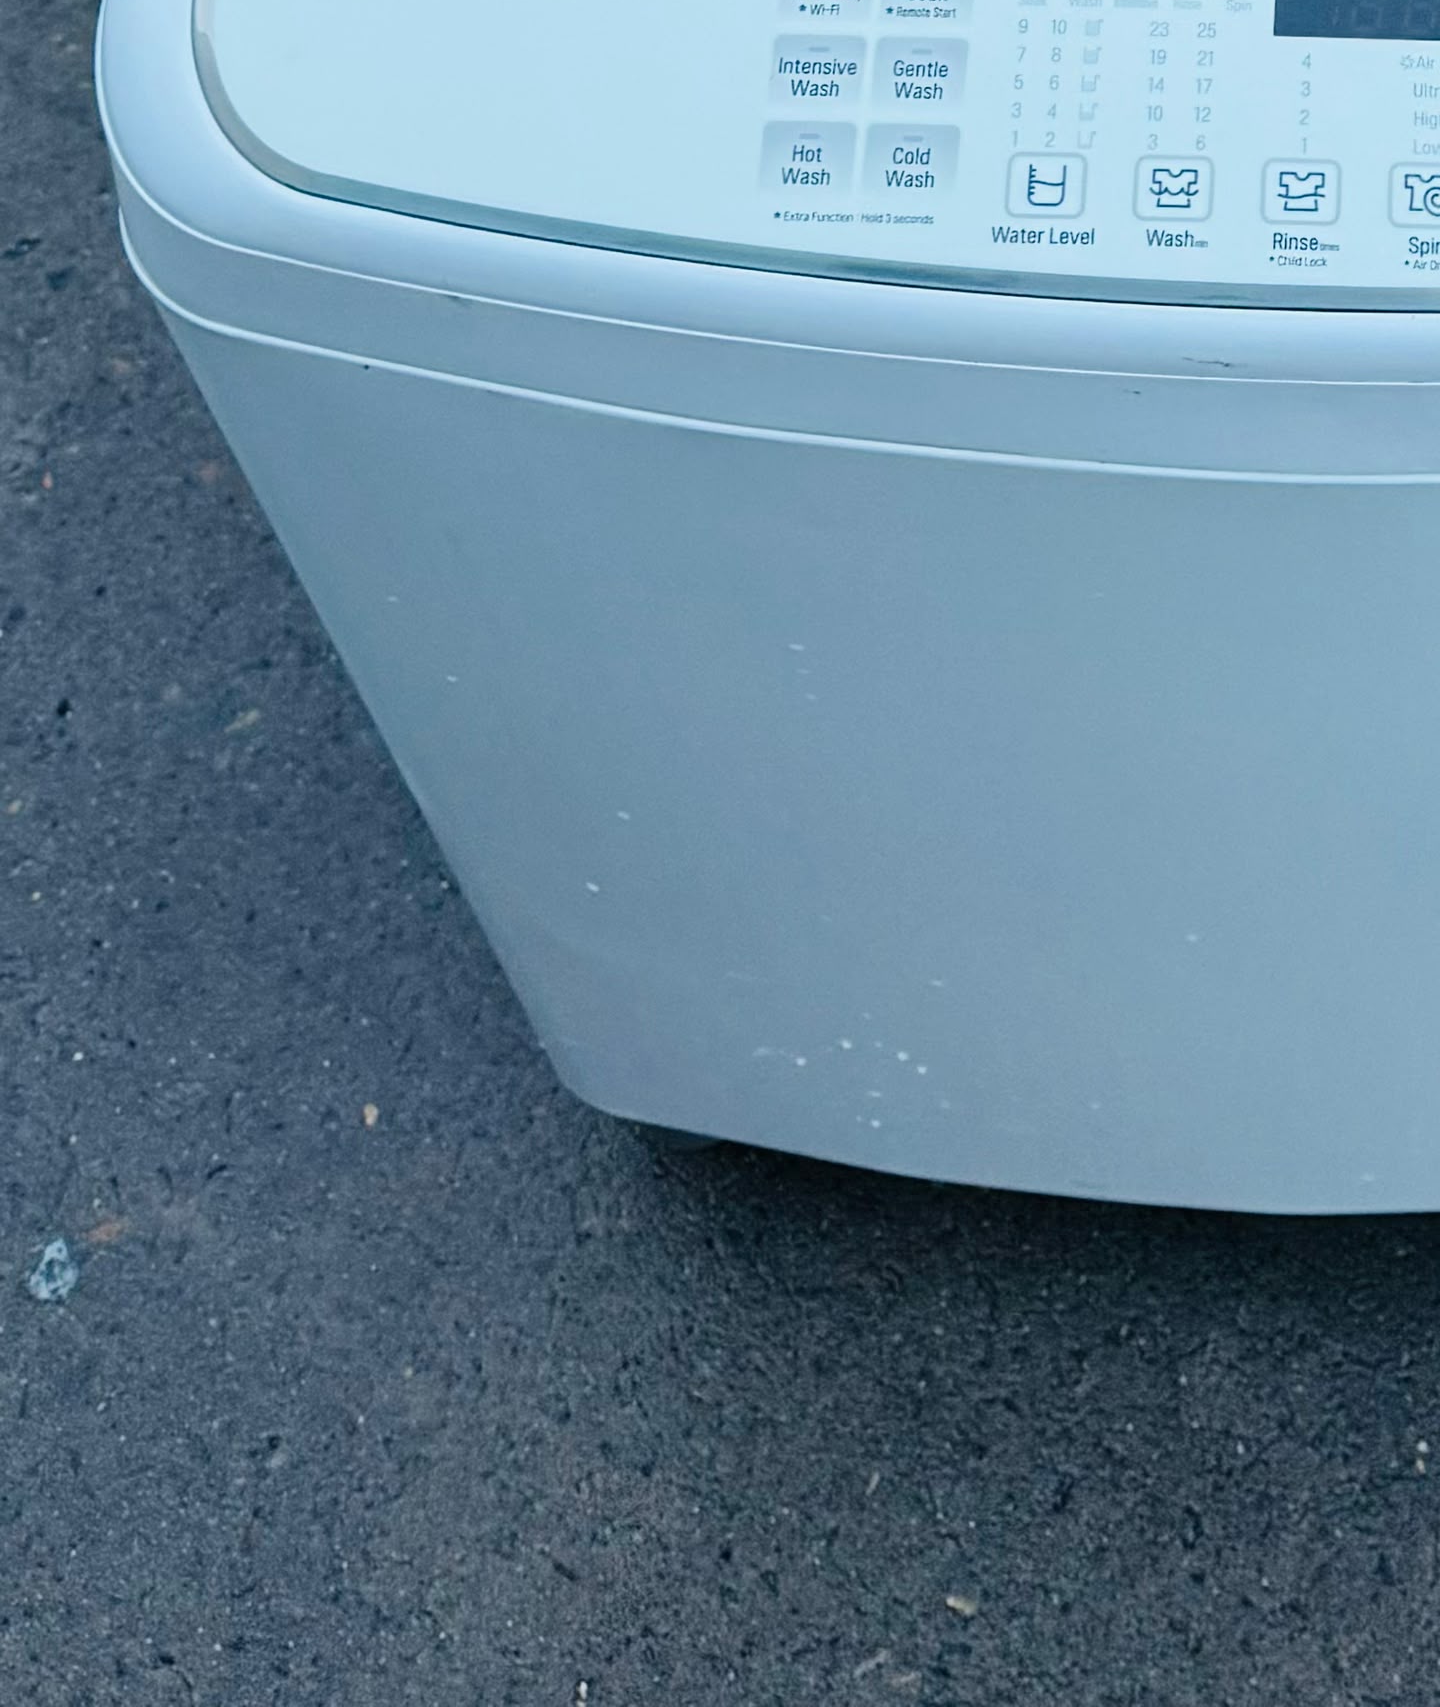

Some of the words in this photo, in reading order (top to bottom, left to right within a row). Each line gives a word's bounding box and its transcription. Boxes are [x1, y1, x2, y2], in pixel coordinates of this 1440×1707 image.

[809, 3, 840, 16] Wi-Fi
[933, 6, 957, 19] Start
[1225, 0, 1253, 13] Spin
[1017, 18, 1029, 34] 9
[1051, 18, 1068, 34] 10
[1149, 21, 1170, 37] 23
[1197, 22, 1217, 38] 25
[1017, 47, 1027, 63] 7
[1051, 47, 1062, 63] 8
[1150, 49, 1167, 65] 19
[1197, 50, 1215, 67] 21
[1301, 53, 1312, 70] 4
[1415, 55, 1436, 71] Air
[778, 56, 858, 76] Intensive
[892, 59, 949, 78] Gentle
[790, 78, 840, 98] Wash
[1013, 74, 1024, 90] 5
[1049, 75, 1060, 91] 6
[1149, 77, 1165, 93] 14
[1196, 78, 1213, 94] 17
[1300, 81, 1311, 97] 3
[894, 81, 944, 100] Wash
[1011, 102, 1022, 119] 3
[1047, 103, 1057, 119] 4
[1147, 105, 1164, 122] 10
[1194, 106, 1212, 123] 12
[1299, 109, 1310, 126] 2
[1011, 131, 1018, 147] 1
[1045, 132, 1056, 148] 2
[1147, 134, 1158, 151] 3
[1195, 135, 1206, 151] 6
[1301, 137, 1307, 155] 1
[792, 144, 823, 163] Hot
[892, 146, 931, 166] Cold
[781, 166, 831, 186] Wash
[885, 169, 935, 188] Wash
[784, 210, 810, 223] Extra
[811, 211, 854, 224] Function
[860, 213, 883, 224] Hold
[893, 213, 935, 225] seconds
[991, 226, 1045, 244] Water
[1049, 227, 1095, 245] Level
[1146, 228, 1194, 248] Wash
[1272, 232, 1319, 251] Rinse
[1277, 255, 1302, 267] Child
[1304, 257, 1328, 267] Lock
[1413, 260, 1426, 270] Air
